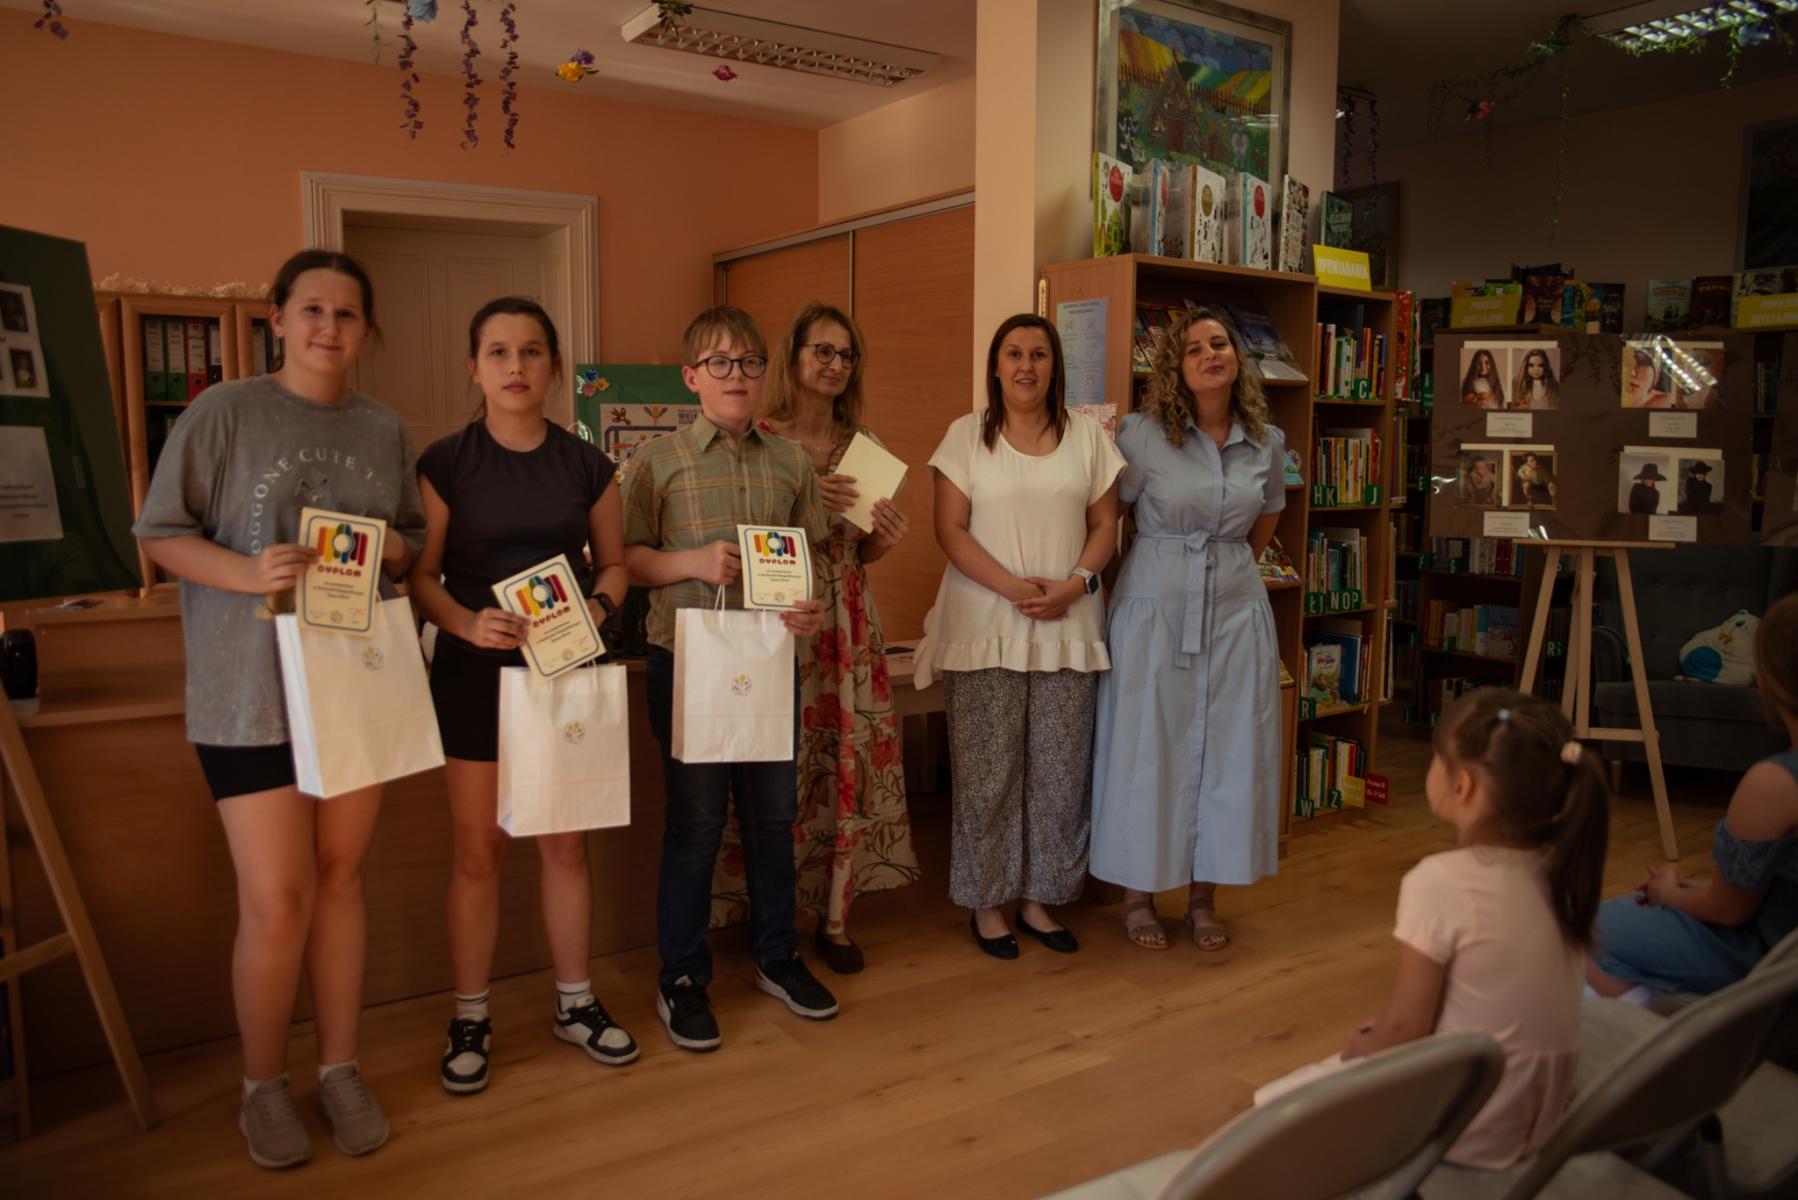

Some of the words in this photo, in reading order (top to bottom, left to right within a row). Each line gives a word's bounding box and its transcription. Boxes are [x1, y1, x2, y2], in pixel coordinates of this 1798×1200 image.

[1358, 380, 1367, 399] C
[251, 457, 293, 554] OGGONE
[299, 448, 357, 471] CUTE
[1313, 485, 1323, 505] H
[1326, 487, 1335, 506] K
[1370, 486, 1378, 505] J
[317, 564, 362, 577] DYPLOM
[1330, 591, 1340, 610] N
[1342, 591, 1351, 610] O
[1352, 591, 1359, 609] P
[532, 605, 571, 628] DYPLOM
[1301, 700, 1310, 719] R
[1300, 799, 1312, 818] W
[1330, 791, 1339, 809] Z
